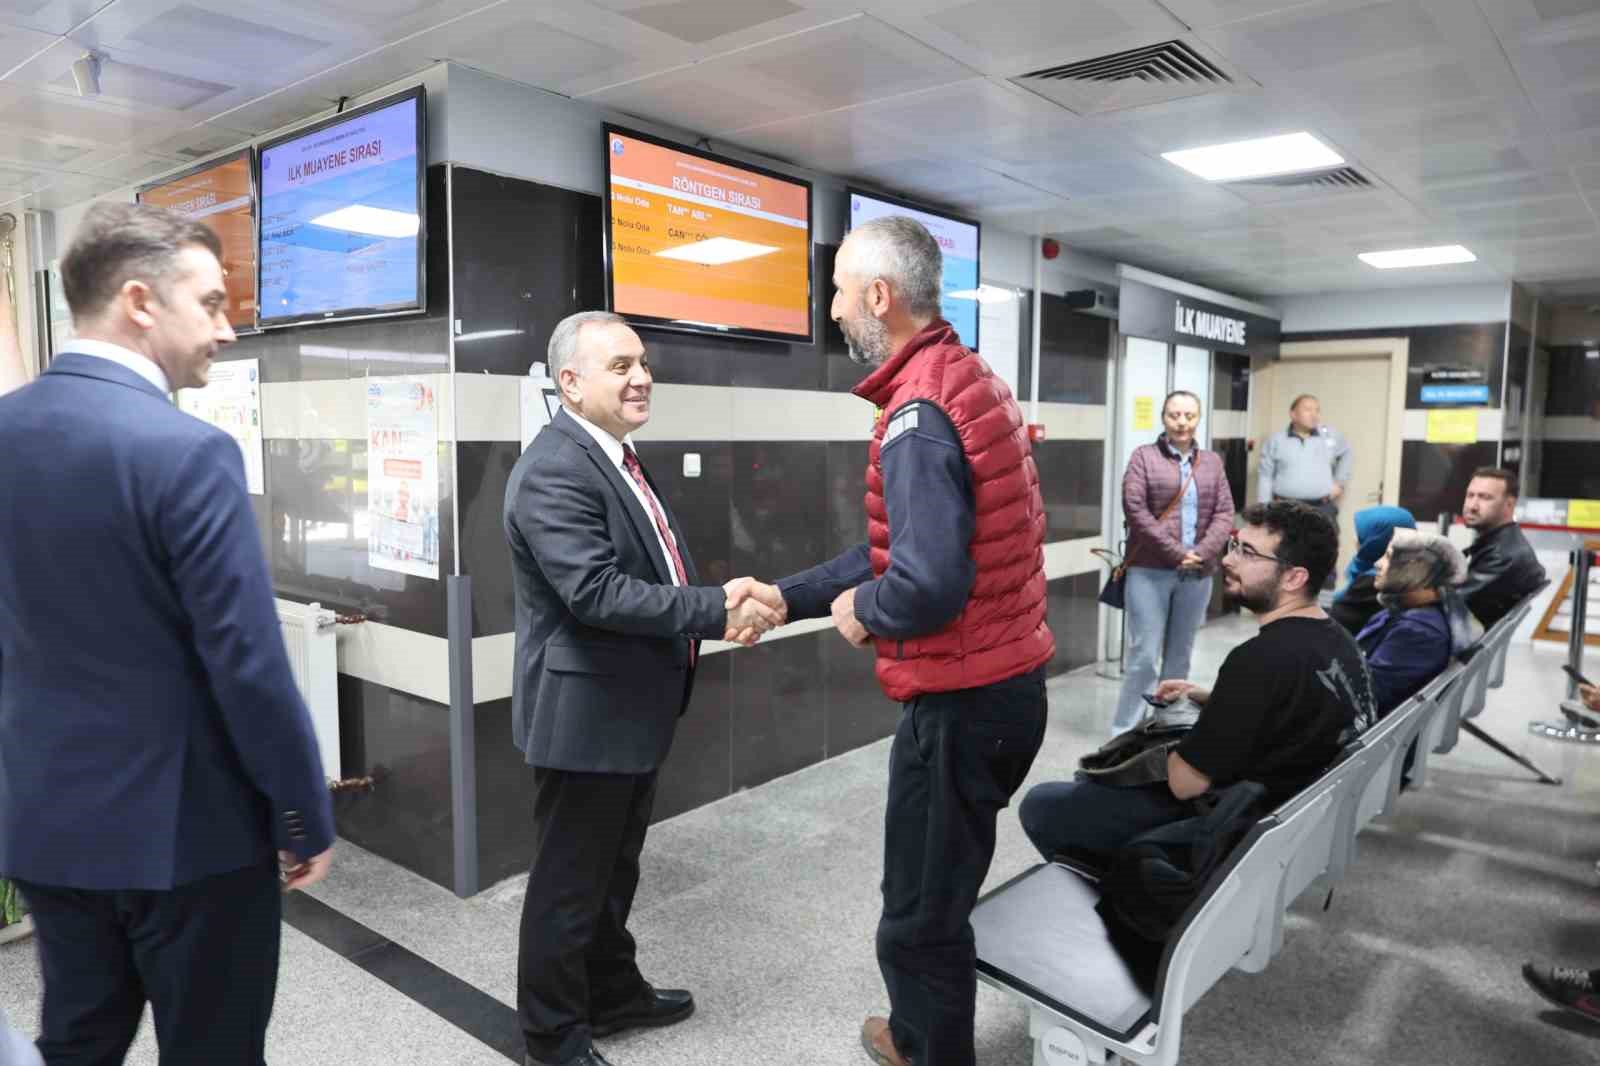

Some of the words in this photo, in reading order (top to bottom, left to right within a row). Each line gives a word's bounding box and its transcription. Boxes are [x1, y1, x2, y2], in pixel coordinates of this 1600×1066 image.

[304, 151, 348, 177] MUAYENE
[350, 139, 382, 162] SIRASI
[672, 175, 726, 201] RÖNTGEN
[728, 189, 761, 209] SIRASI
[1175, 299, 1194, 335] İLK
[1195, 310, 1247, 346] MUAYENE
